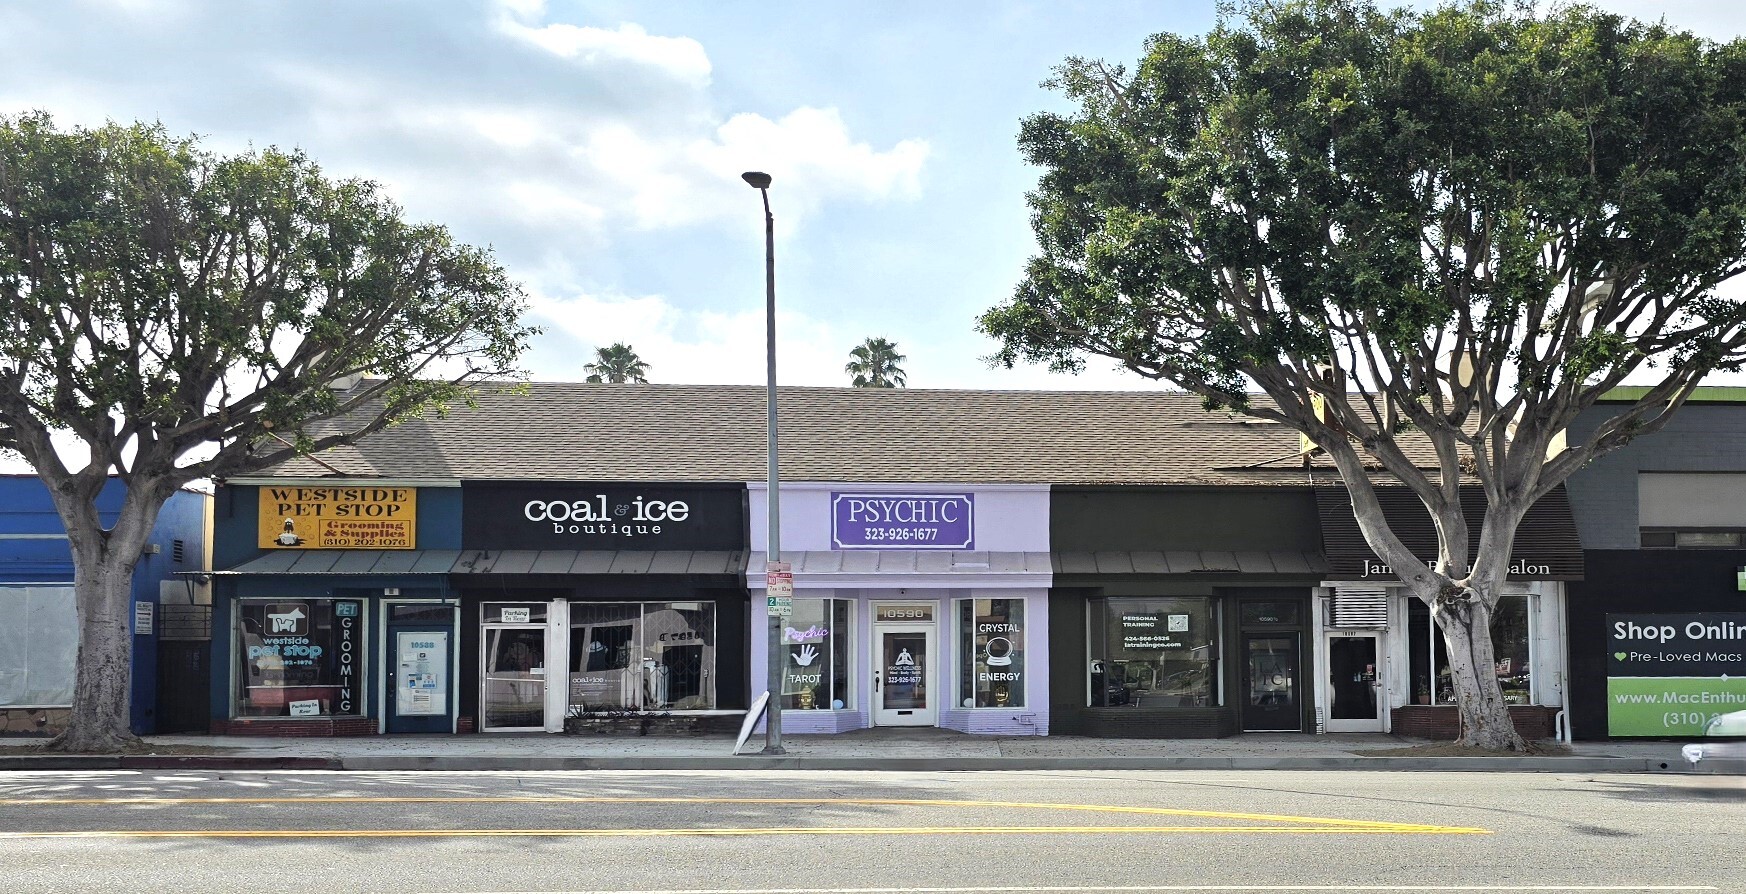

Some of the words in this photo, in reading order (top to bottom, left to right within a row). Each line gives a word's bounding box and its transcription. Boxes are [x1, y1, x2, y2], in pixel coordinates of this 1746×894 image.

[269, 488, 407, 502] WESTSIDE
[277, 503, 327, 516] PET
[335, 503, 401, 516] STOP
[525, 494, 612, 522] coal
[614, 504, 630, 516] &
[632, 495, 689, 522] ice
[848, 500, 958, 523] PSYCHIC
[327, 520, 404, 531] Grooming
[553, 523, 661, 537] boutique
[340, 530, 406, 538] Supplies
[864, 528, 938, 540] 323-926-1677
[323, 538, 351, 546] (310)
[354, 538, 406, 546] 202-1076
[1507, 559, 1550, 575] alon
[337, 604, 355, 615] PET
[884, 610, 924, 618] 10590
[784, 625, 829, 642] Psychic
[979, 624, 1020, 632] CRYSTAL
[1614, 622, 1676, 643] Shop
[249, 646, 280, 660] pet
[284, 645, 322, 660] stop
[1630, 652, 1701, 662] Pre-Loved
[1706, 652, 1742, 662] Macs
[341, 618, 352, 711] GROOMING
[790, 674, 822, 683] TAROT
[980, 672, 1020, 681] ENERGY
[1663, 712, 1705, 728] (310)
